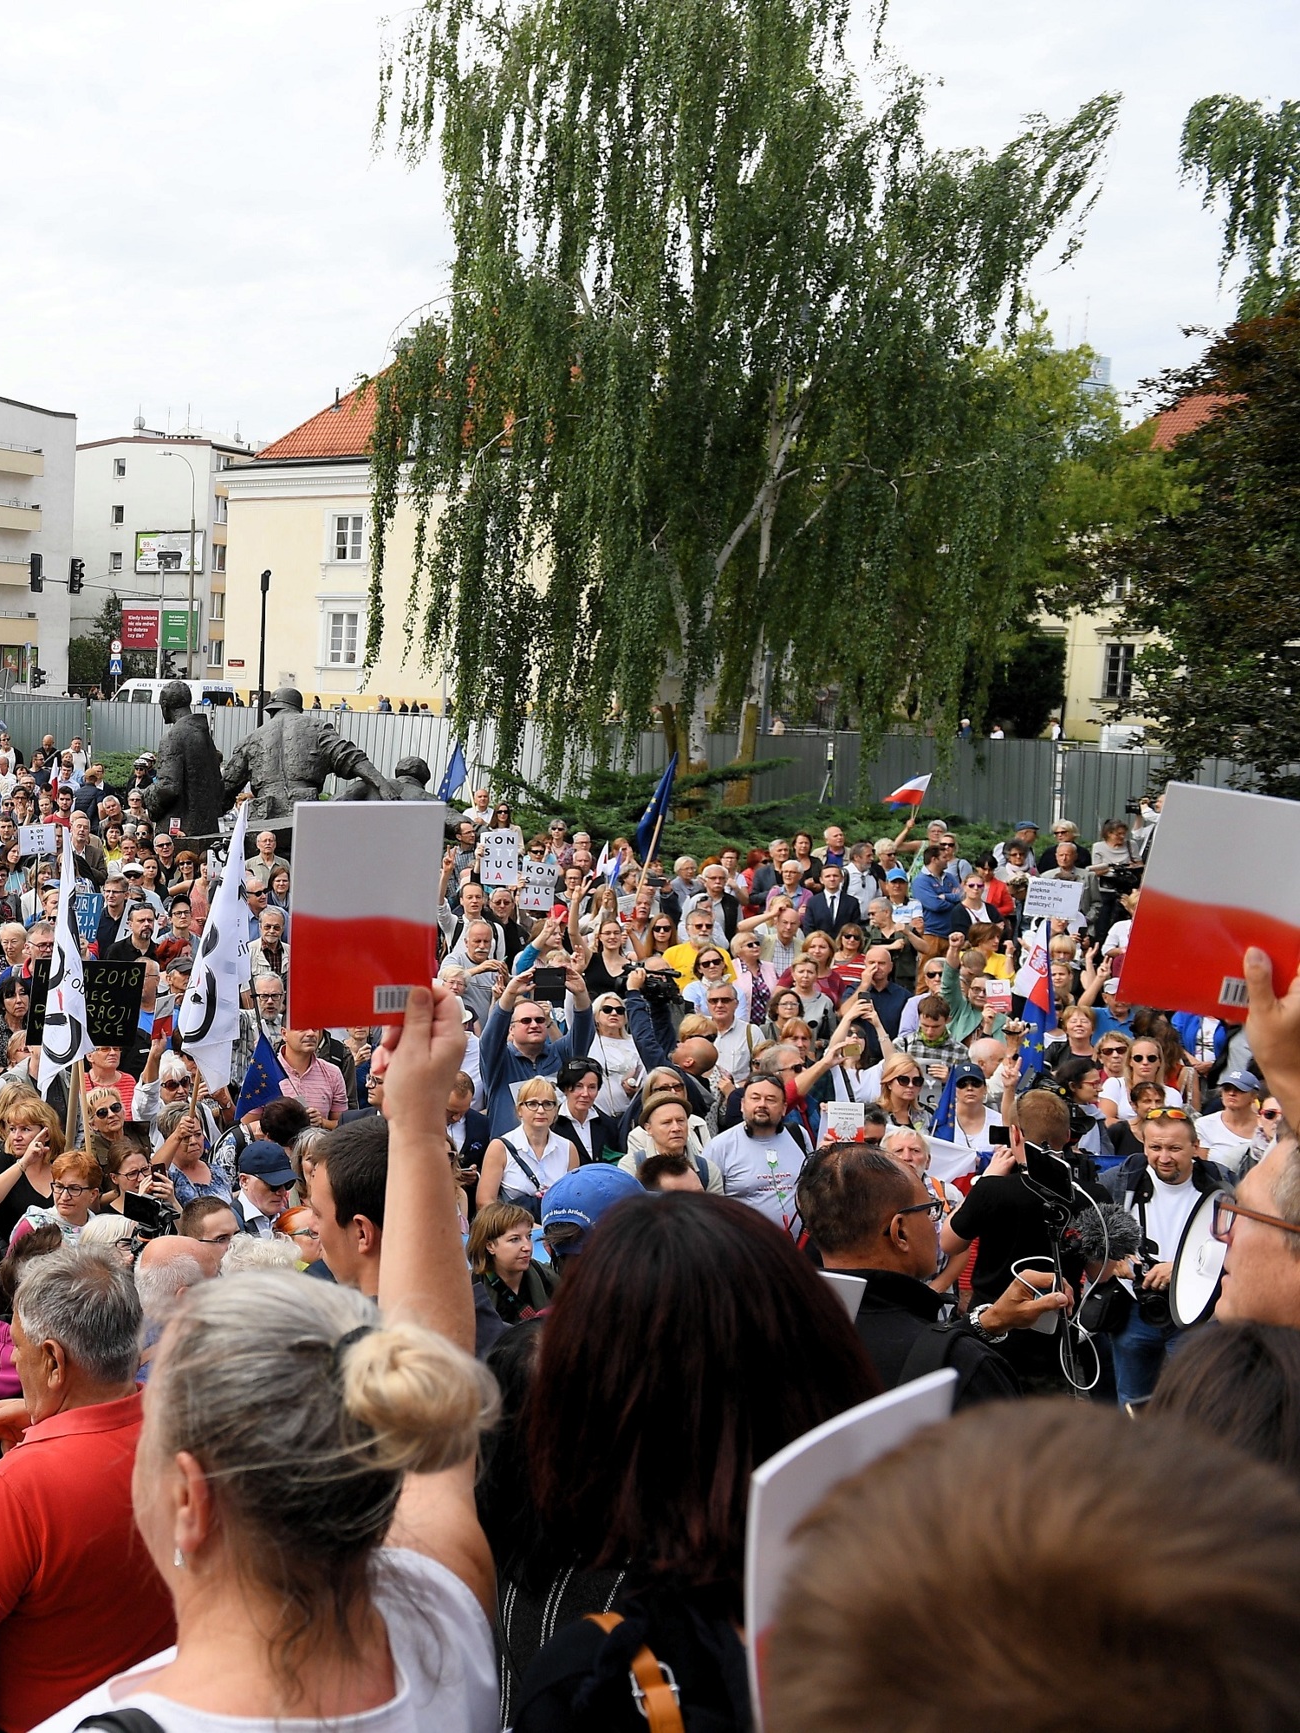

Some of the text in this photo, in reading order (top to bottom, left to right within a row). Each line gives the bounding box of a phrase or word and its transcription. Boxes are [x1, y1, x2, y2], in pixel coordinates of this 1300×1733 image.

[485, 848, 514, 856] STY
[526, 866, 555, 876] KON
[525, 877, 553, 885] STY
[524, 887, 550, 895] TUC
[92, 896, 98, 913] 1
[38, 964, 46, 984] 4
[94, 968, 140, 988] 2018
